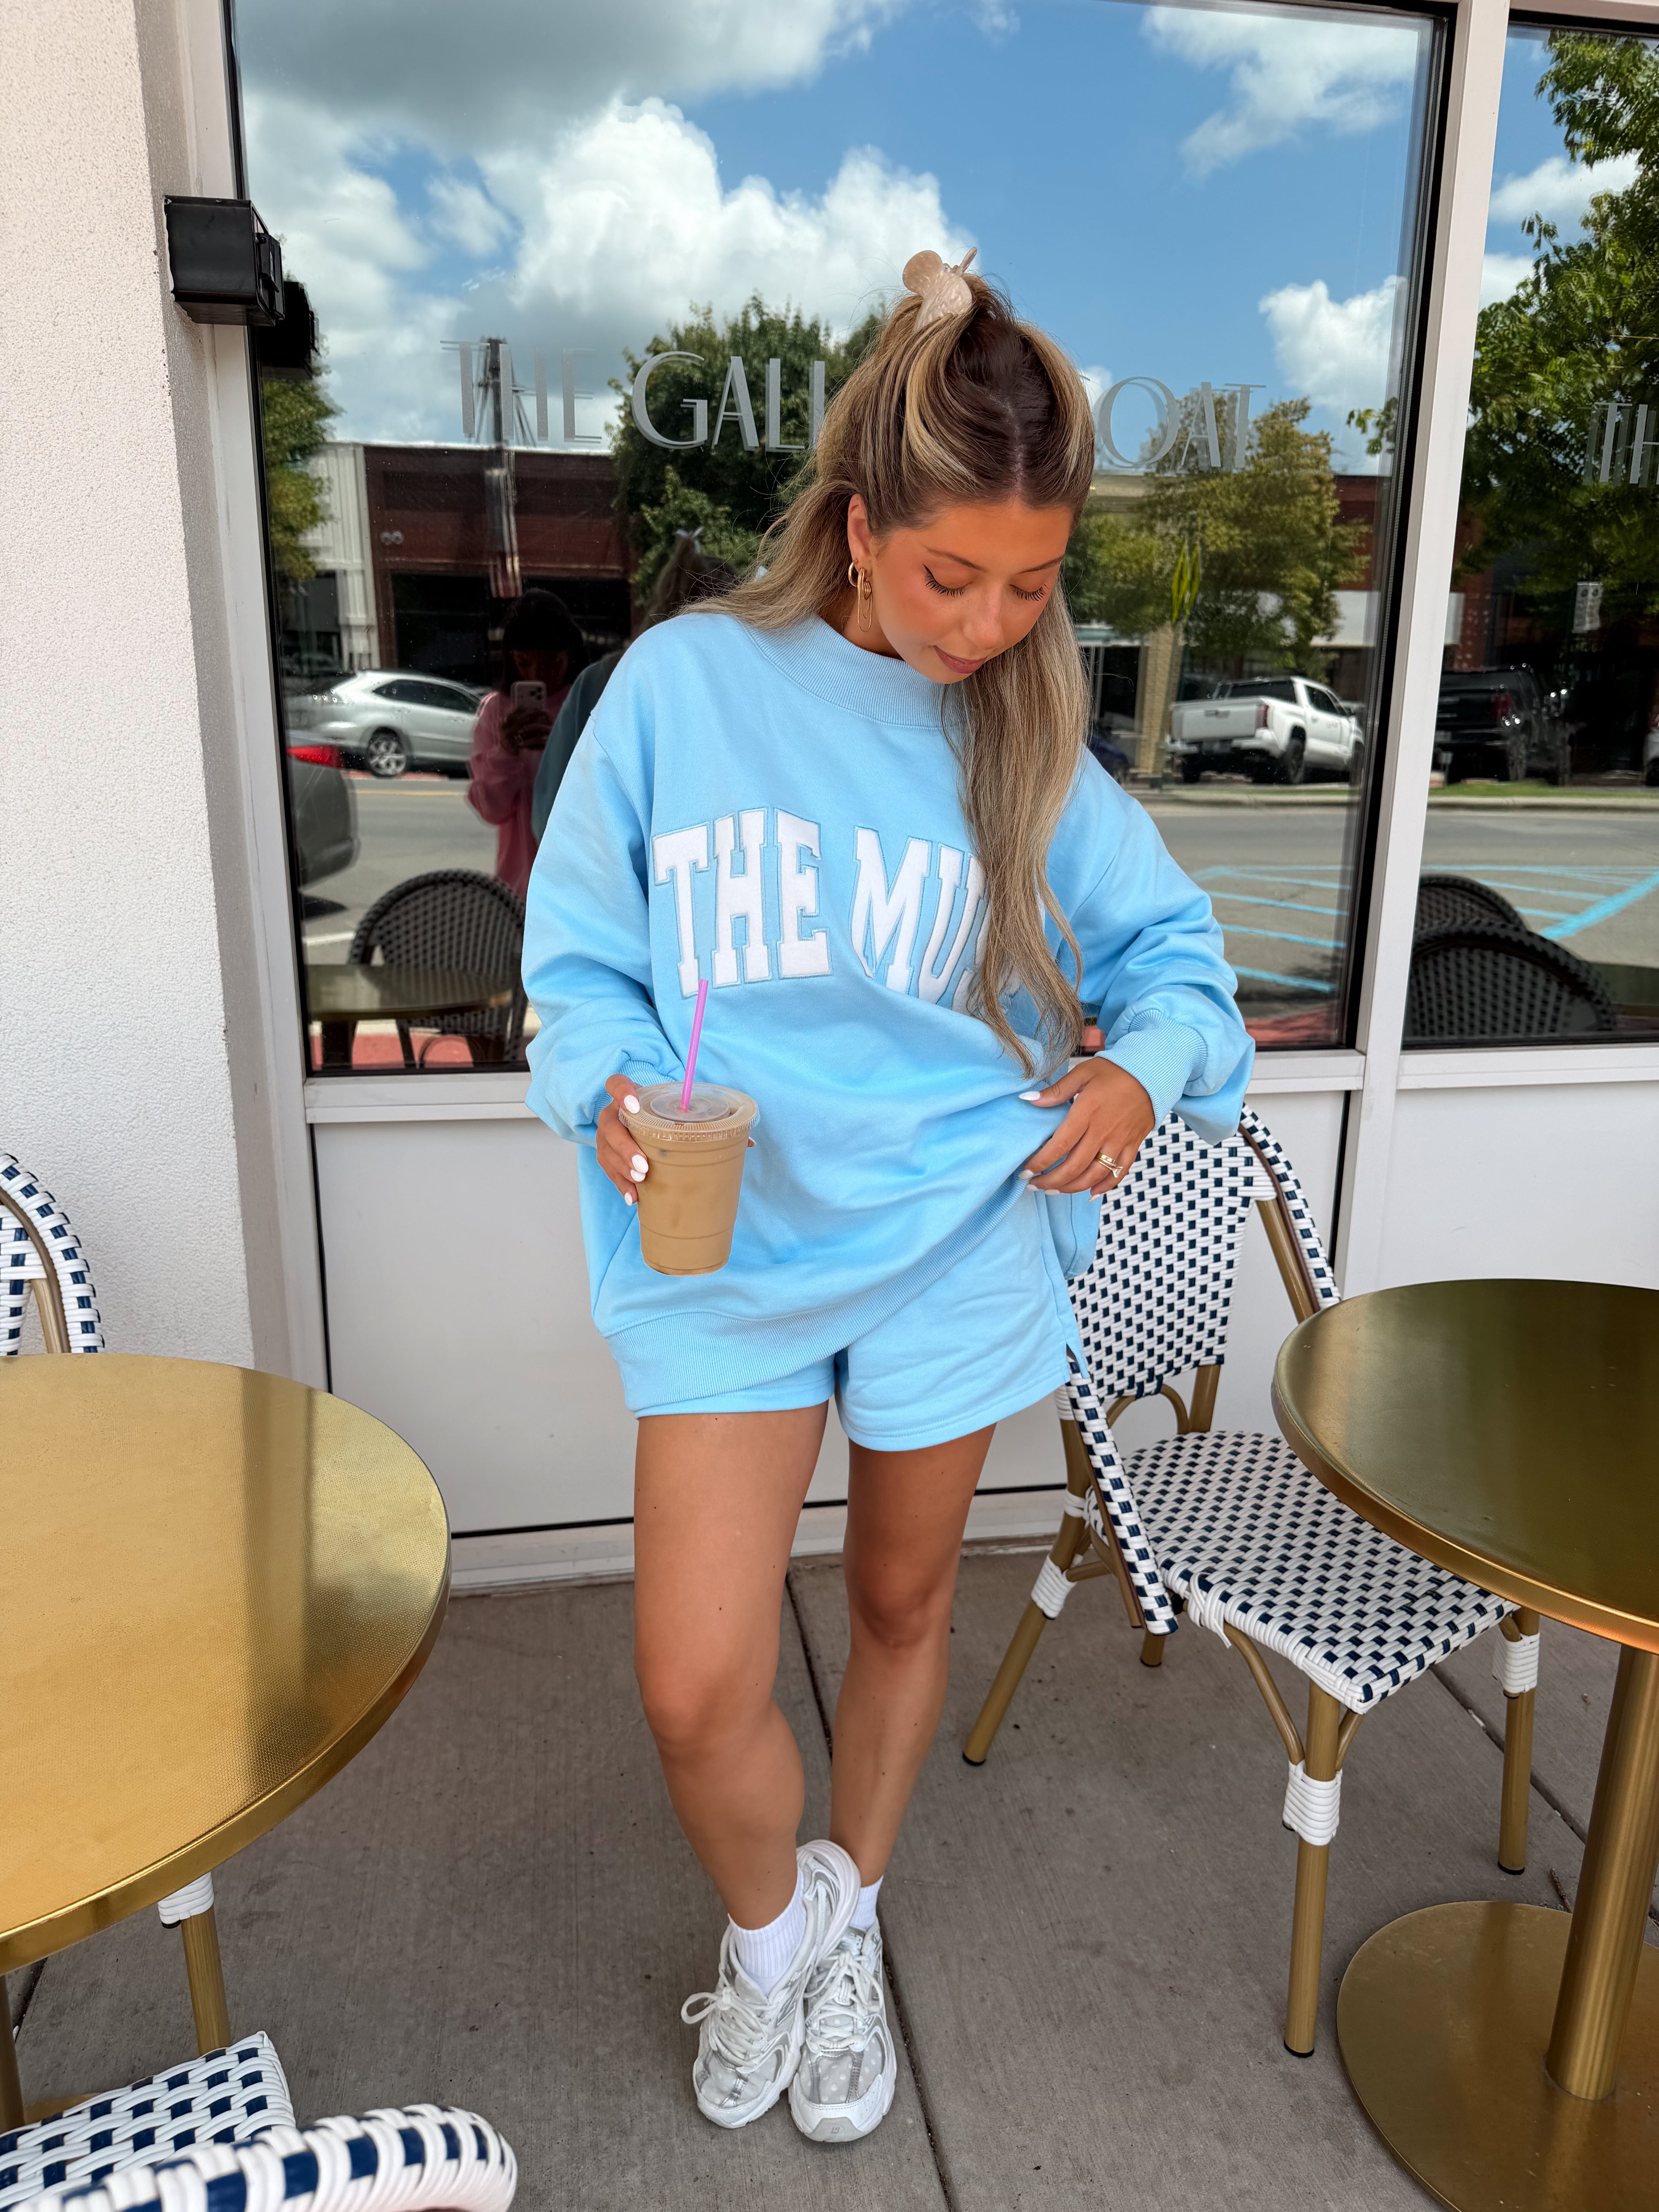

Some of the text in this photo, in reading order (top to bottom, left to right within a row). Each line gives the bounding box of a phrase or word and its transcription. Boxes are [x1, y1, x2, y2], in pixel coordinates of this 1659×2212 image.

[440, 340, 1267, 468] THE GALL OAT
[653, 806, 833, 999] THE
